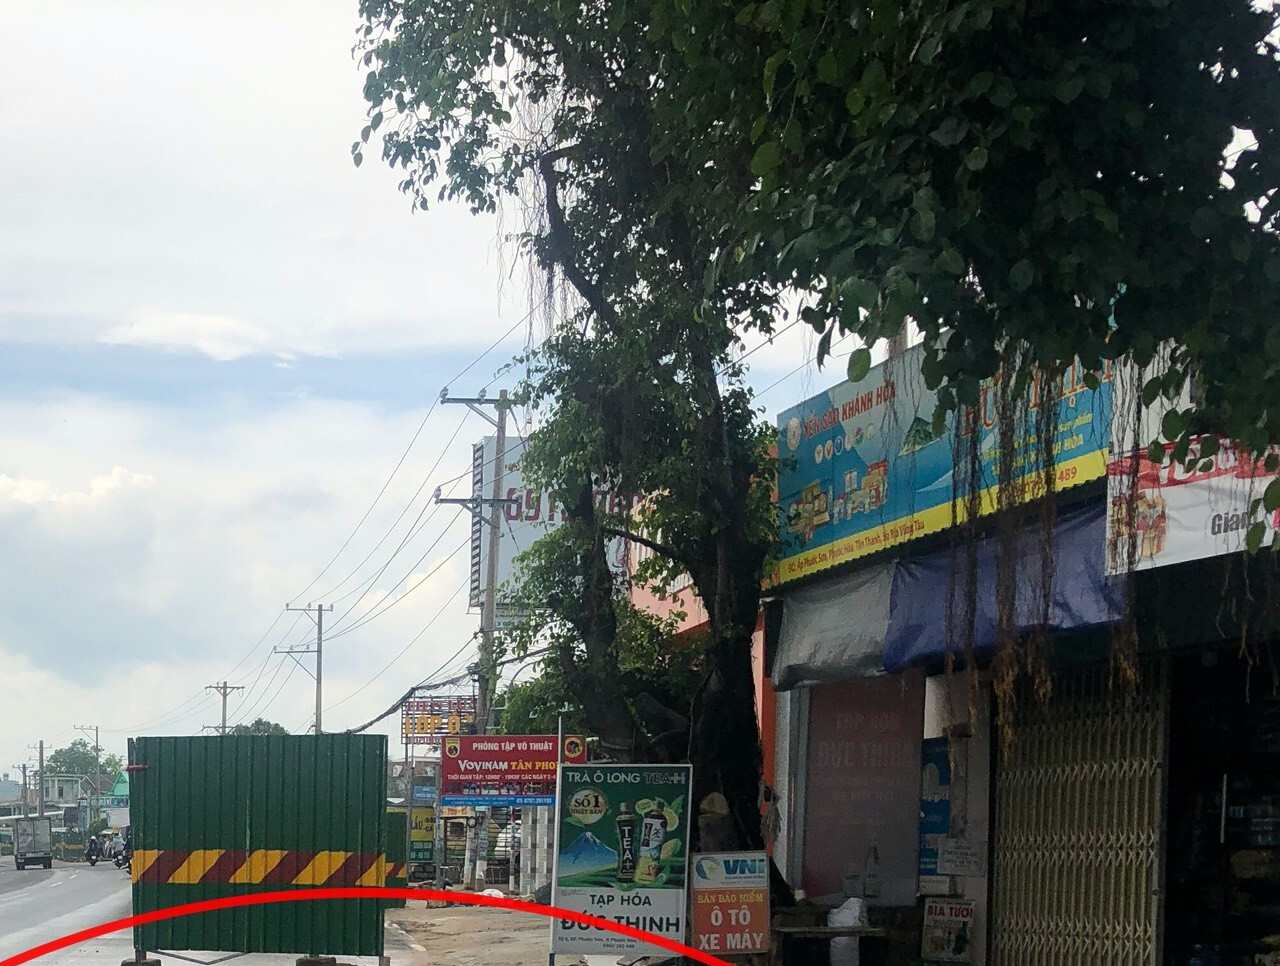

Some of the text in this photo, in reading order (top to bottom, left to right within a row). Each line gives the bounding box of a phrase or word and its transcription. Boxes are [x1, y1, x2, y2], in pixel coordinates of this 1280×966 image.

[841, 391, 873, 422] KHÁNH
[1057, 466, 1078, 483] 489
[472, 740, 499, 751] PHÒNG
[501, 741, 516, 752] TẬP
[529, 741, 553, 752] THUẬT
[458, 759, 508, 772] VOVINAM
[510, 759, 532, 770] TÂN
[566, 769, 591, 783] TRÀ
[593, 769, 605, 783] Ô
[607, 772, 640, 783] LONG
[593, 793, 601, 808] 1
[589, 891, 652, 909] TẠP HÓA
[710, 904, 751, 927] Ô TÔ
[698, 928, 764, 950] XE MÁY
